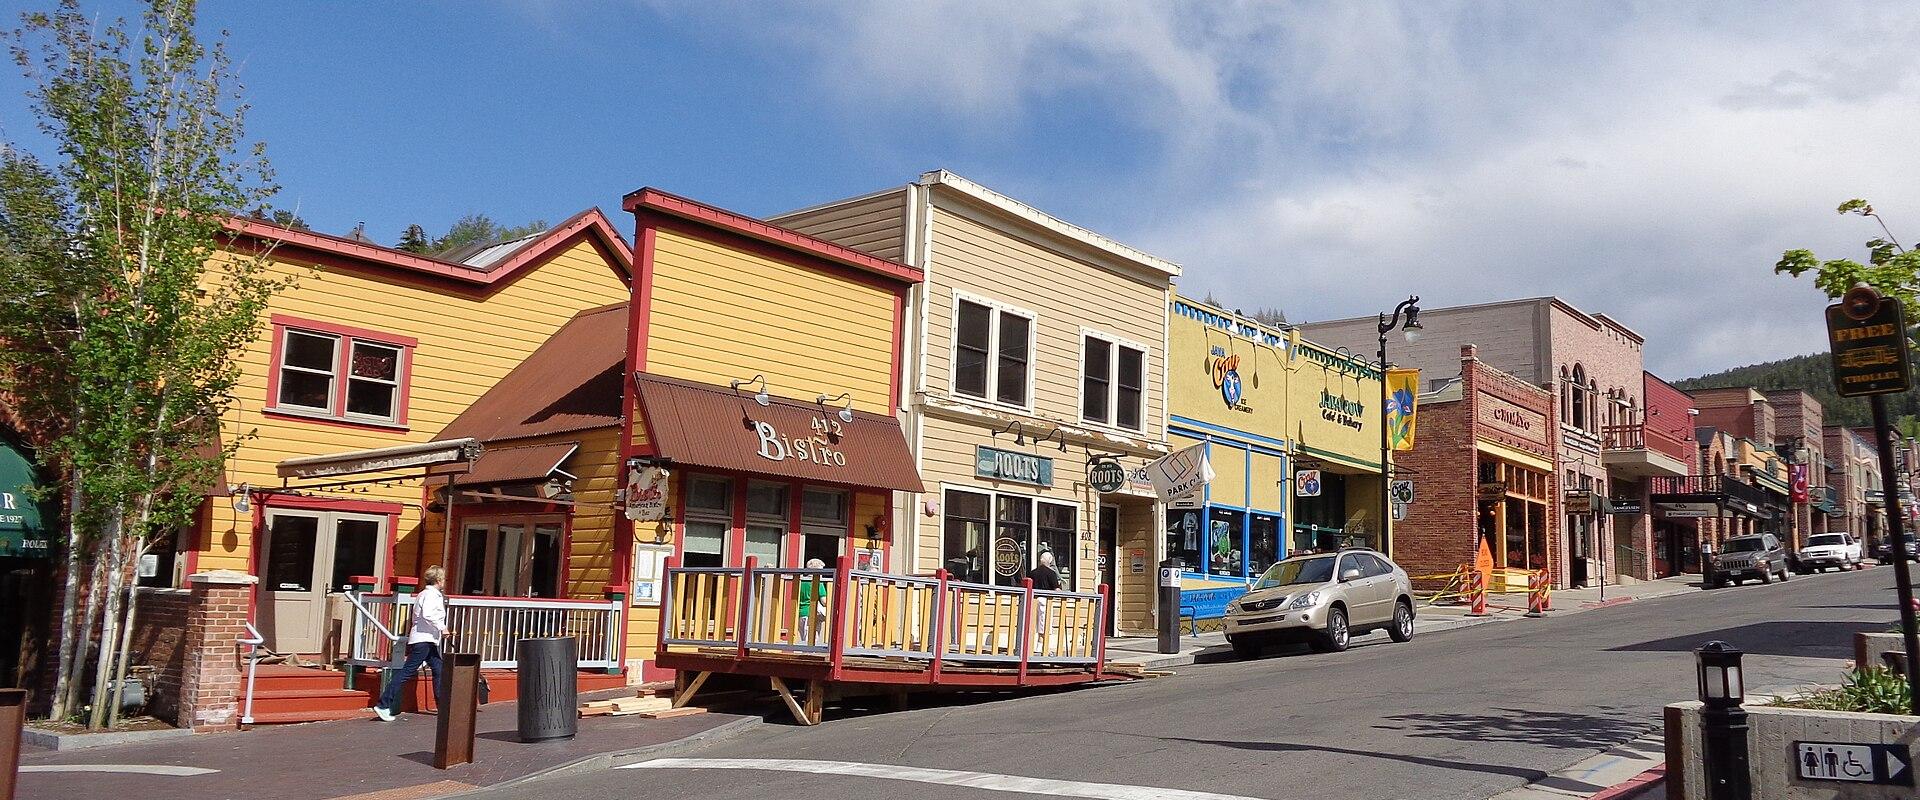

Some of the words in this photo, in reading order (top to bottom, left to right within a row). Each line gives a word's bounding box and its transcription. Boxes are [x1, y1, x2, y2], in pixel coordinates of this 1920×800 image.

[1834, 324, 1896, 342] FREE
[811, 416, 843, 437] 412
[755, 420, 846, 467] Bistro
[994, 452, 1039, 480] ROOTS
[1091, 469, 1123, 484] ROOTS
[1167, 482, 1188, 496] PARK
[6, 515, 23, 523] 1927
